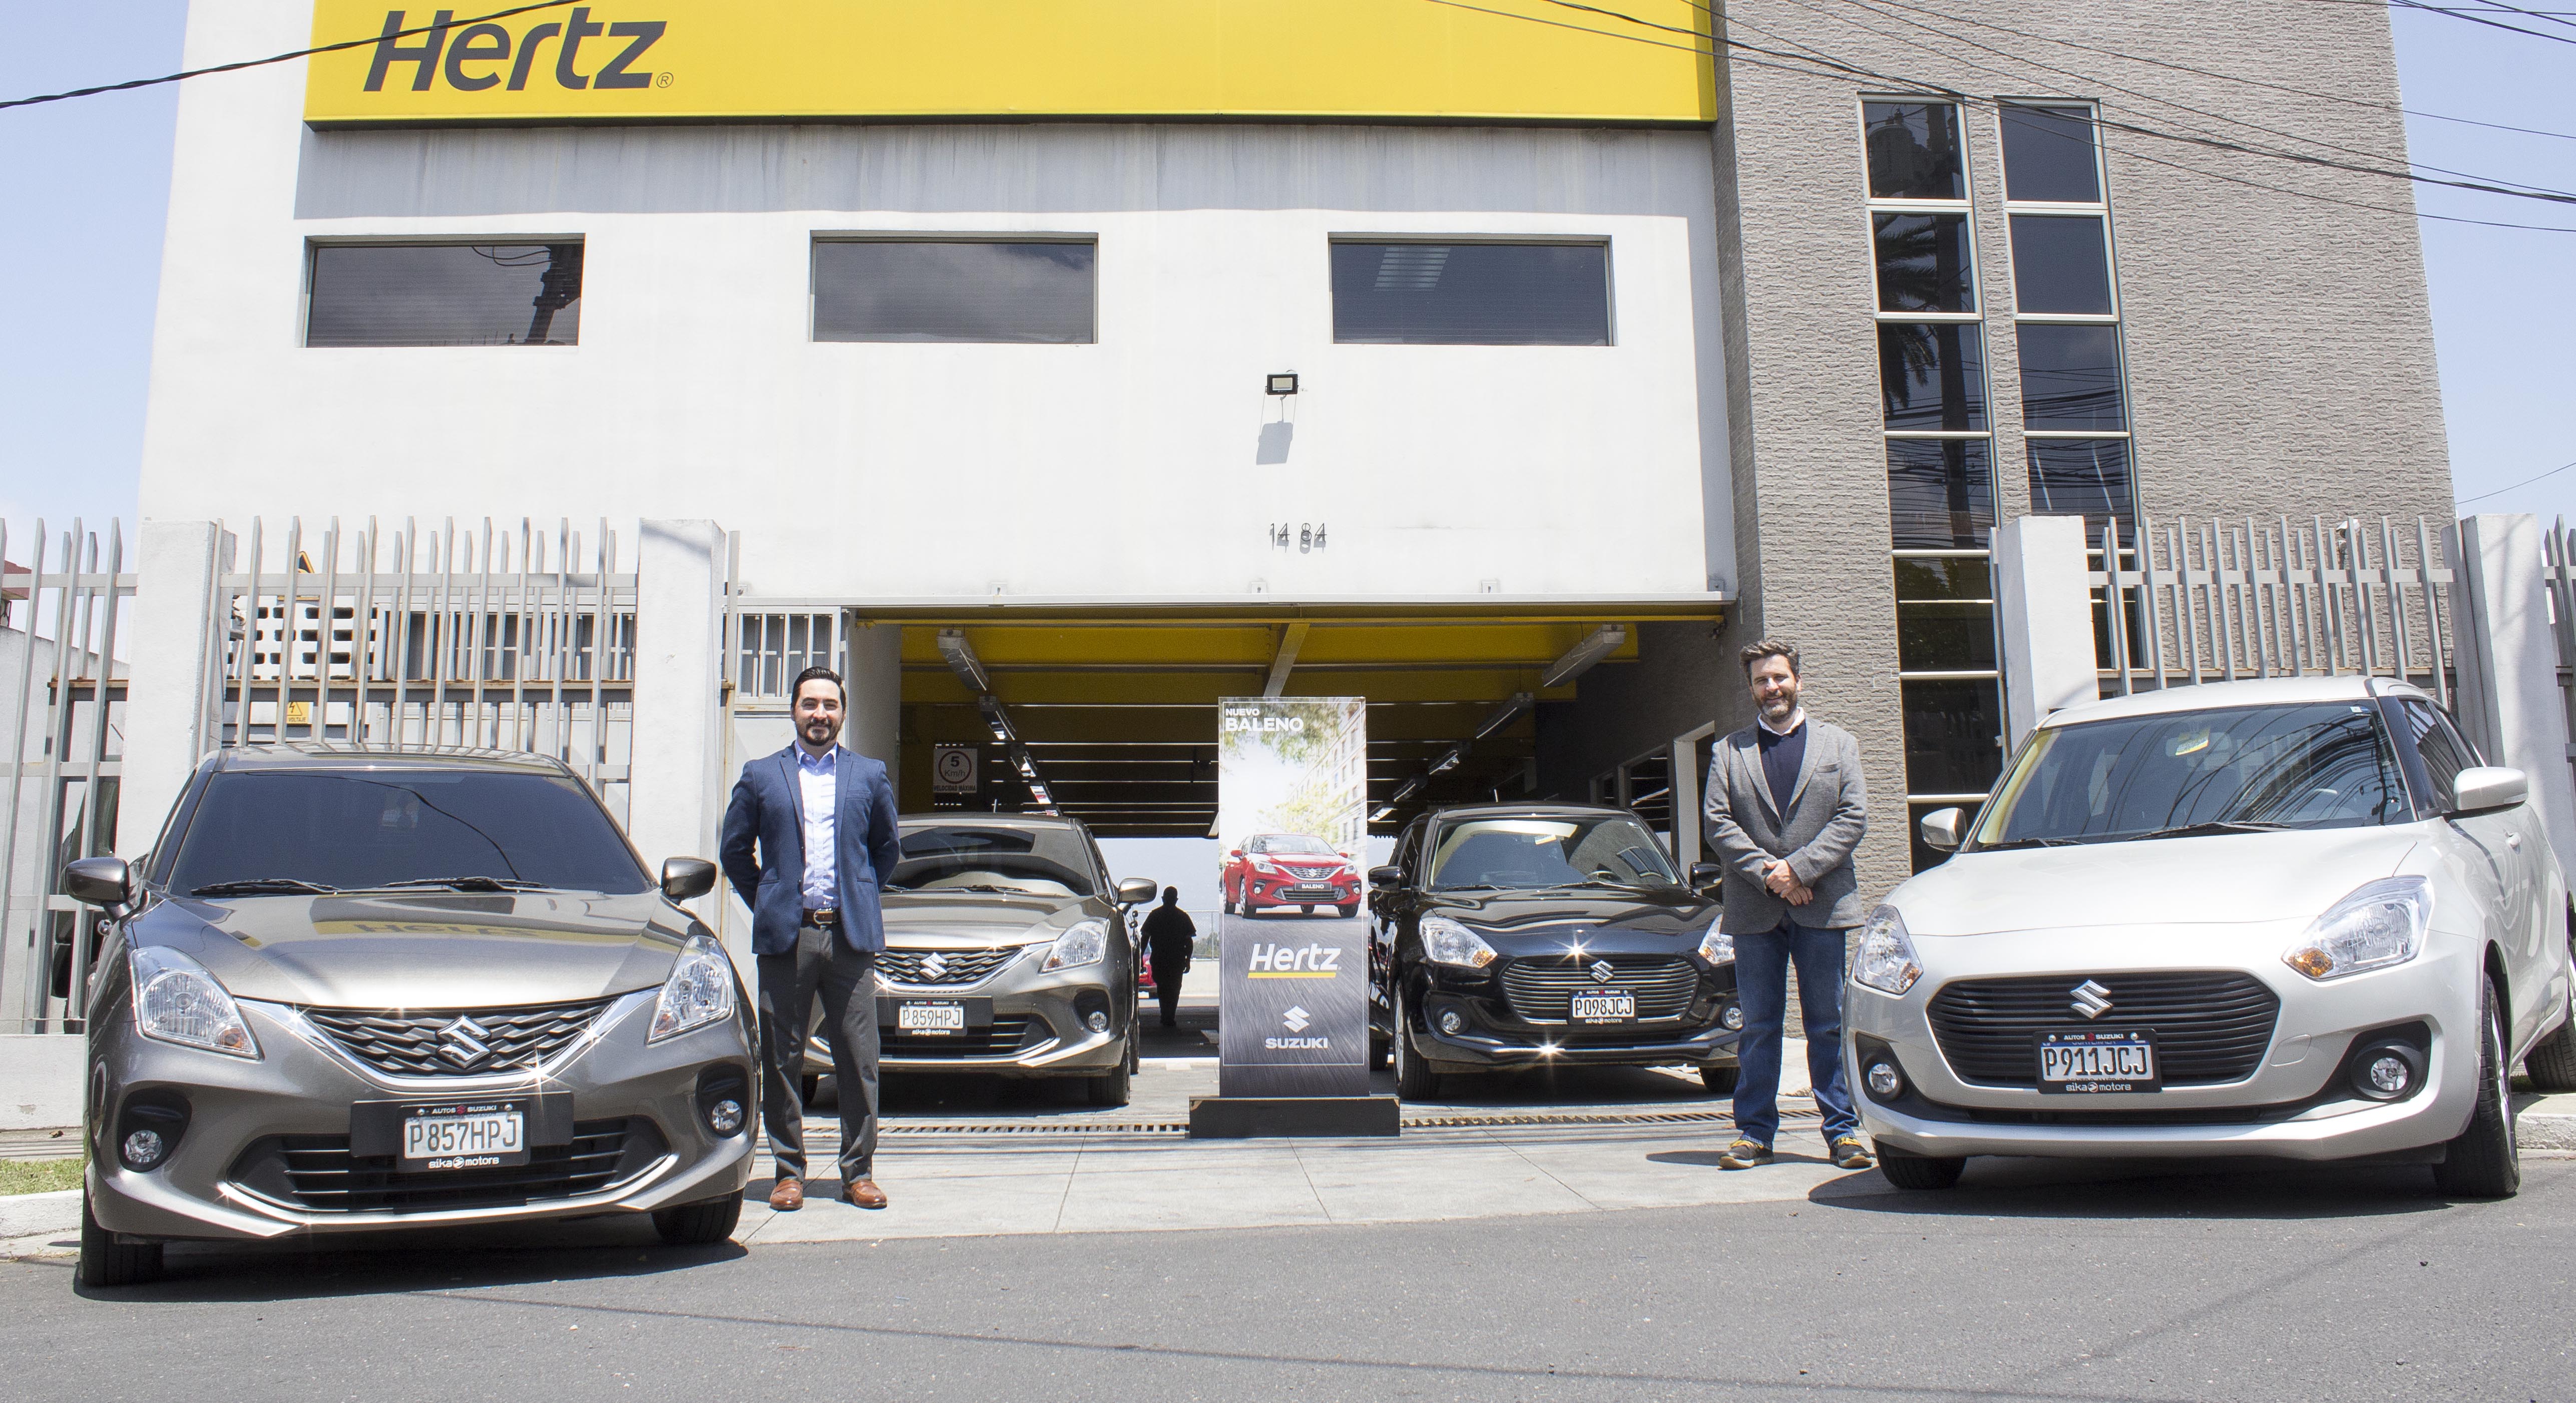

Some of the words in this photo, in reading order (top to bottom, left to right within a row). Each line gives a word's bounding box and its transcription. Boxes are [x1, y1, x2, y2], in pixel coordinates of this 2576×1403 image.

[363, 7, 667, 92] Hertz
[1225, 708, 1260, 716] NUEVO
[1225, 718, 1304, 732] BALENO
[951, 756, 960, 767] 5
[1249, 943, 1342, 971] Hertz
[903, 1010, 961, 1025] P859HPJ
[1265, 1037, 1328, 1049] SUZUKI
[2043, 1046, 2147, 1076] P911JCJ
[2066, 1082, 2087, 1092] sika
[2099, 1083, 2131, 1091] motors
[432, 1106, 456, 1114] AUTOS
[410, 1119, 517, 1153] P857HPJ
[428, 1158, 453, 1169] sika
[465, 1156, 500, 1166] motors
